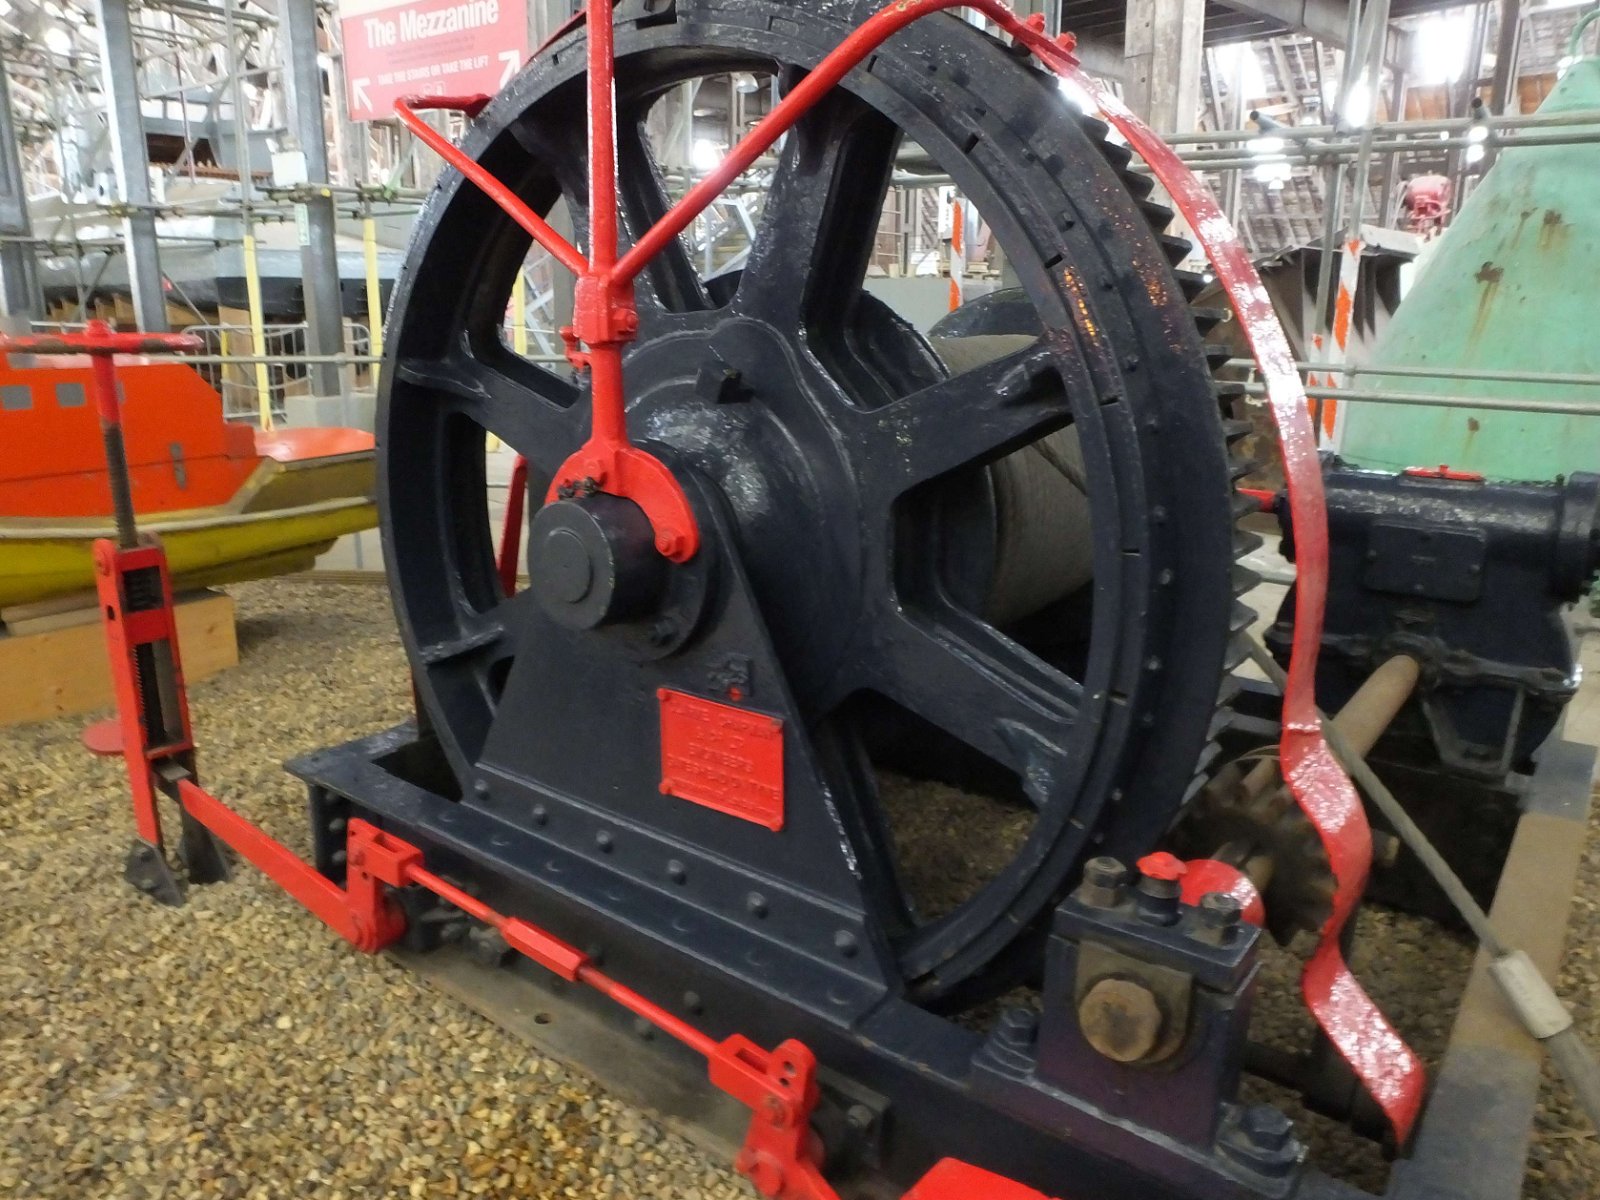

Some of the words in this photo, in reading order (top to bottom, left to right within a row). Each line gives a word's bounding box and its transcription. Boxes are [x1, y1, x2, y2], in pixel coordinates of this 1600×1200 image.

[363, 18, 397, 49] The
[399, 0, 499, 42] Mezzanine
[473, 55, 489, 69] LIFT
